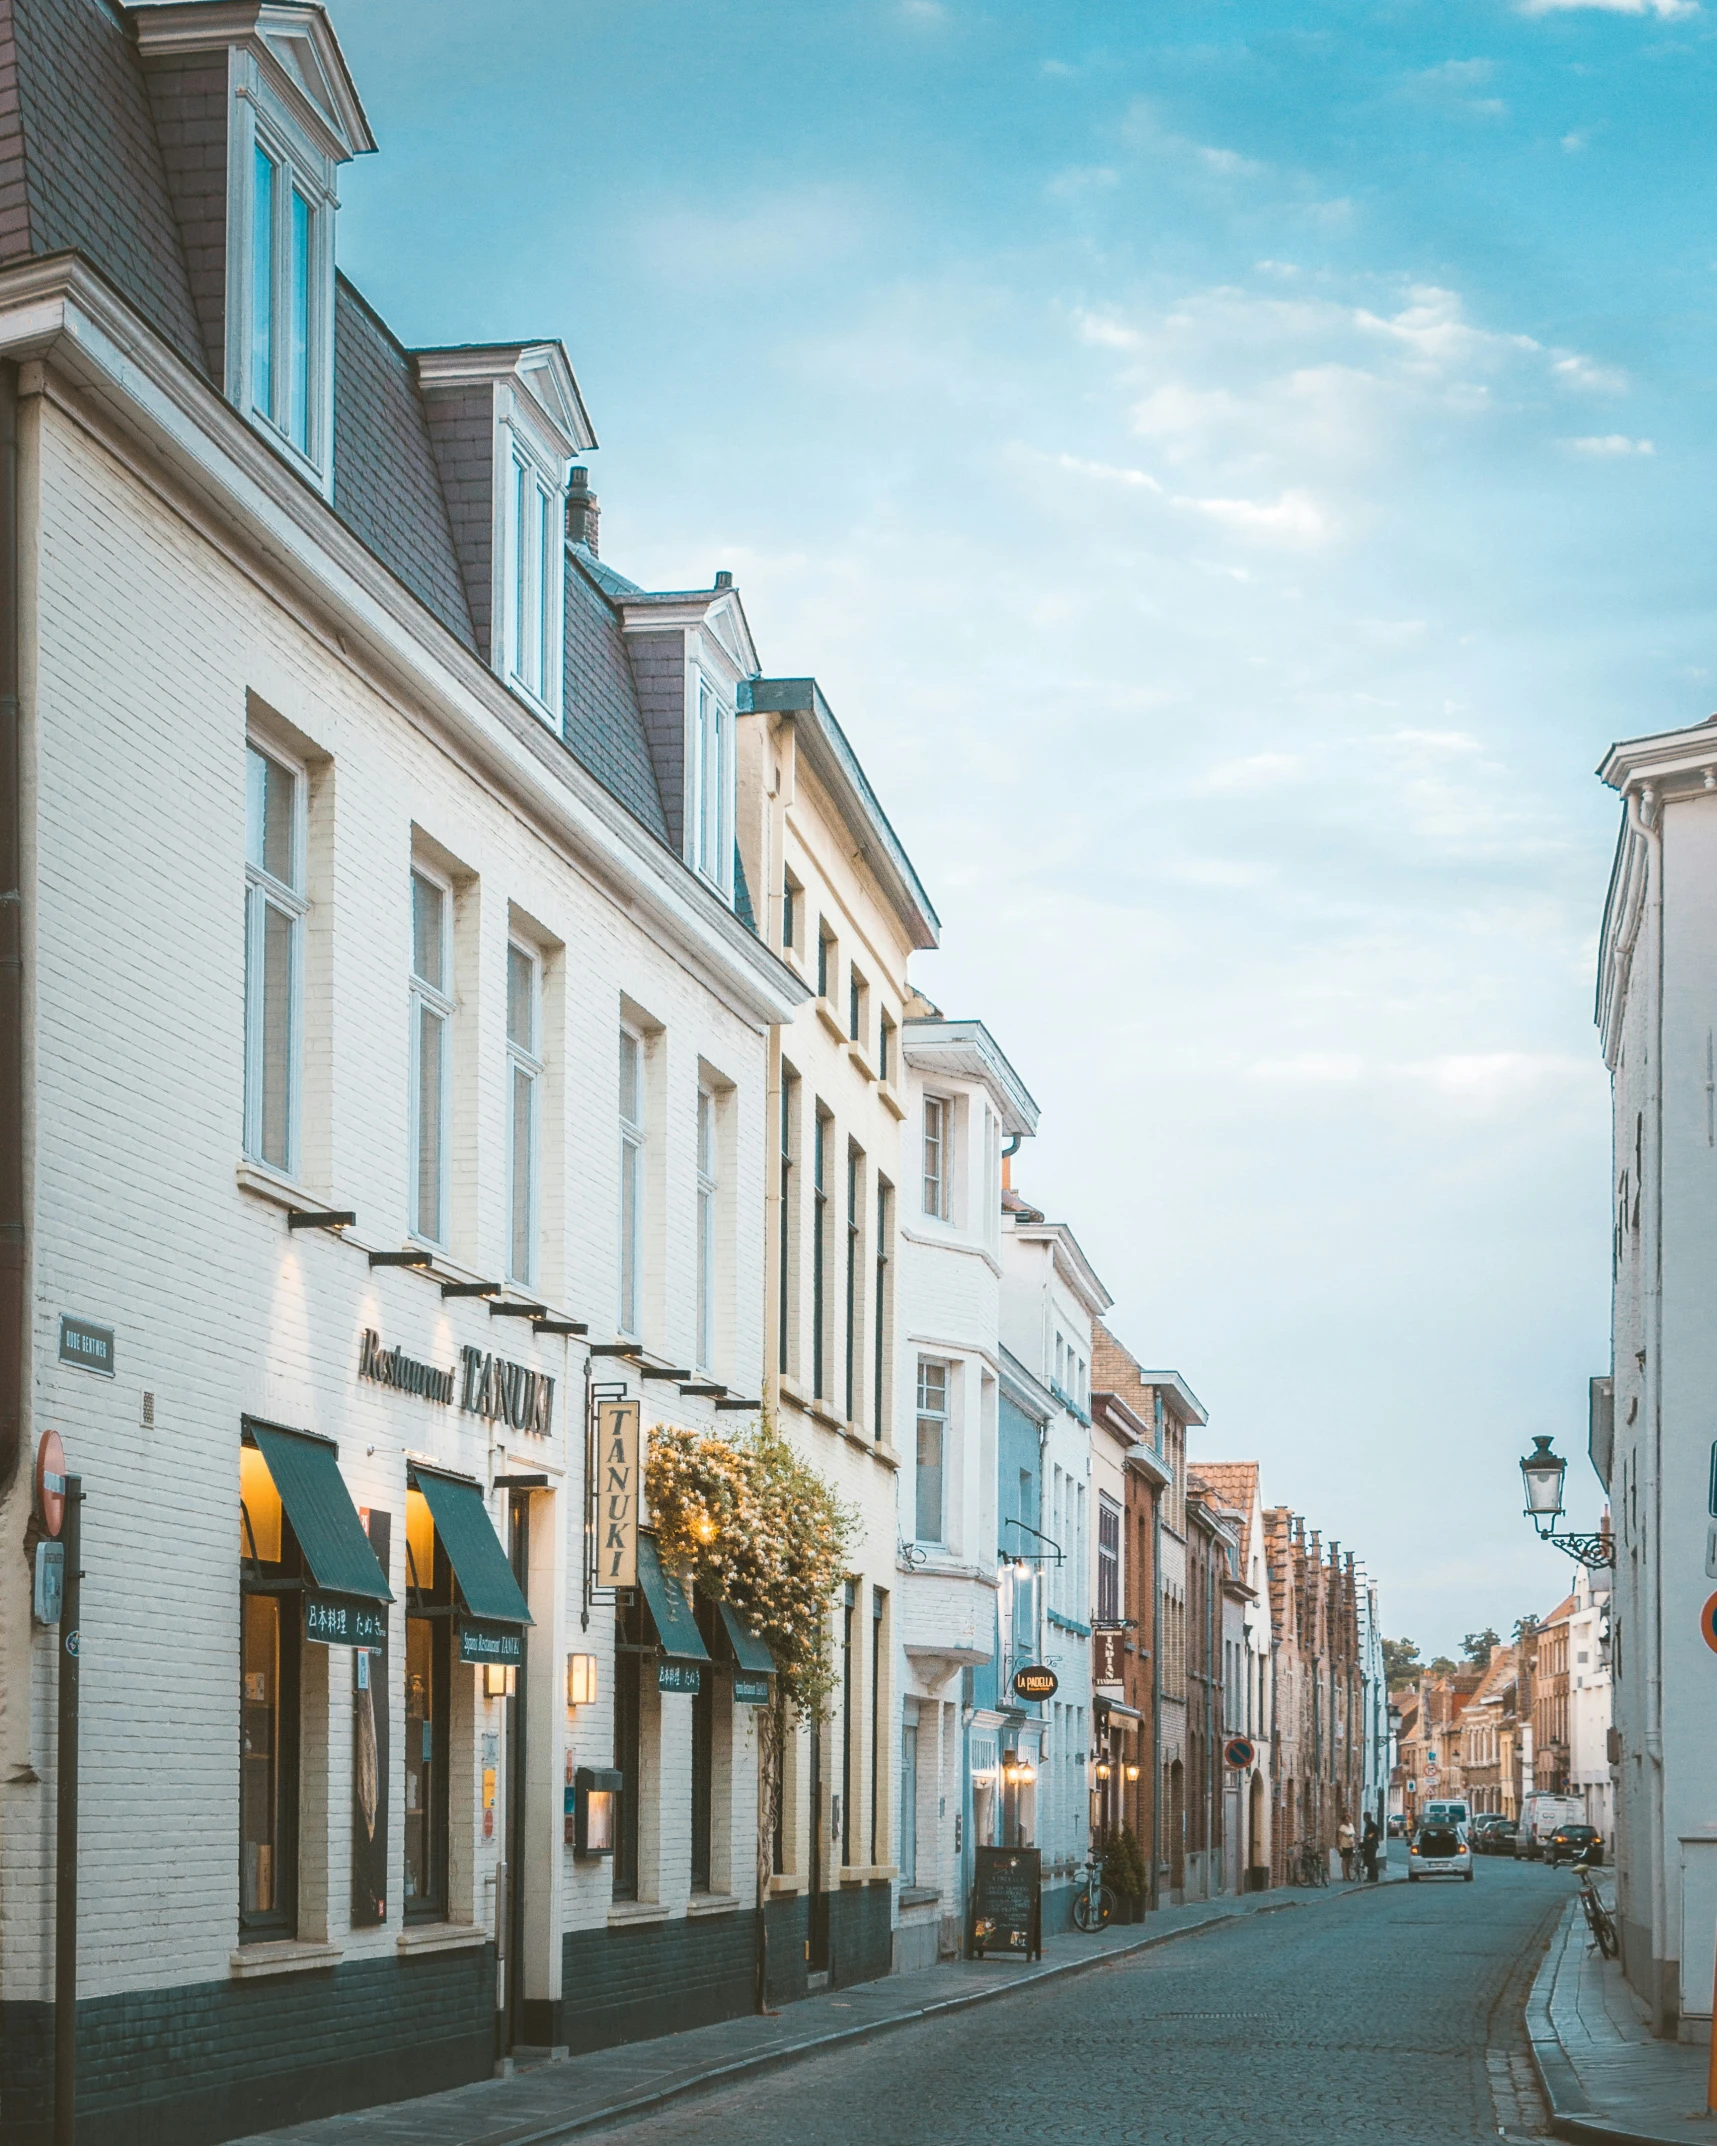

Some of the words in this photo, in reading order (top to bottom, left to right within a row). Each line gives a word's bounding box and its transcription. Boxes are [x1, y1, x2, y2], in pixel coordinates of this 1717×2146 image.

[360, 1328, 455, 1405] Restaurant
[460, 1345, 556, 1437] TANUKI
[605, 1409, 632, 1577] TANUKI
[1105, 1636, 1115, 1679] INDIAN
